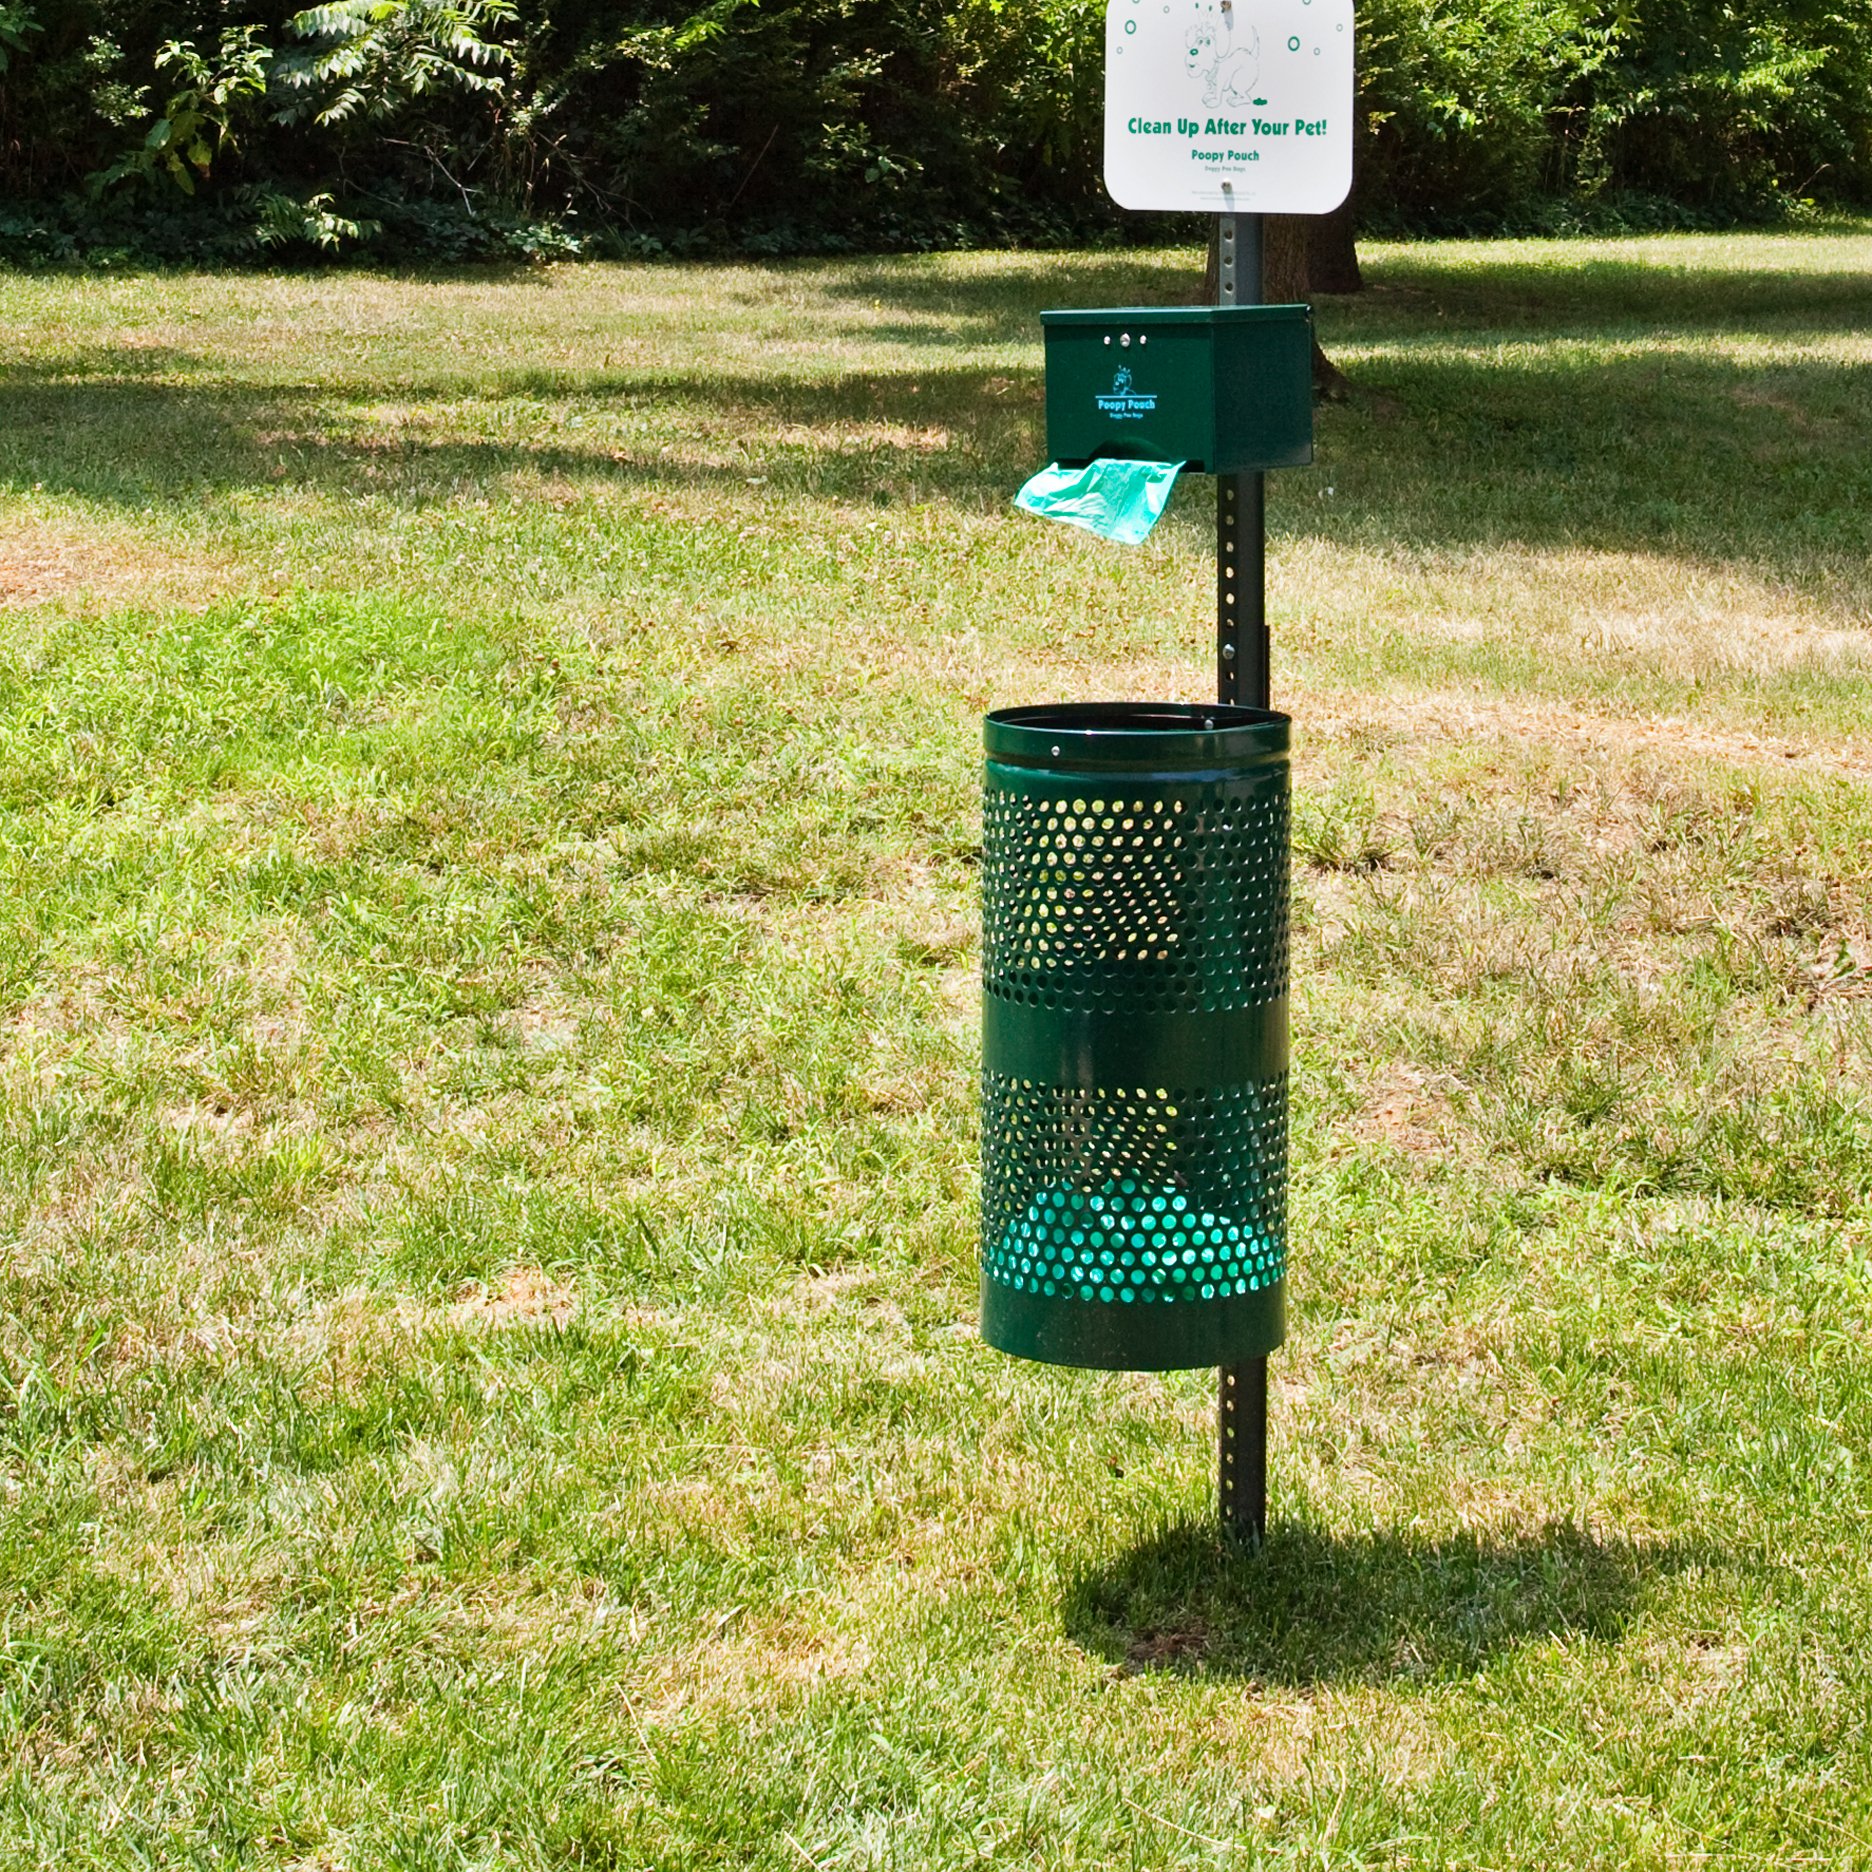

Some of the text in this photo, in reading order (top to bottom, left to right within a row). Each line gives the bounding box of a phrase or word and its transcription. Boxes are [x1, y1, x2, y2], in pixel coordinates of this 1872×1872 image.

[1128, 117, 1328, 138] Clean Up After Your Pet!
[1191, 149, 1260, 163] Poopy Pouch
[1098, 399, 1126, 412] Poopy
